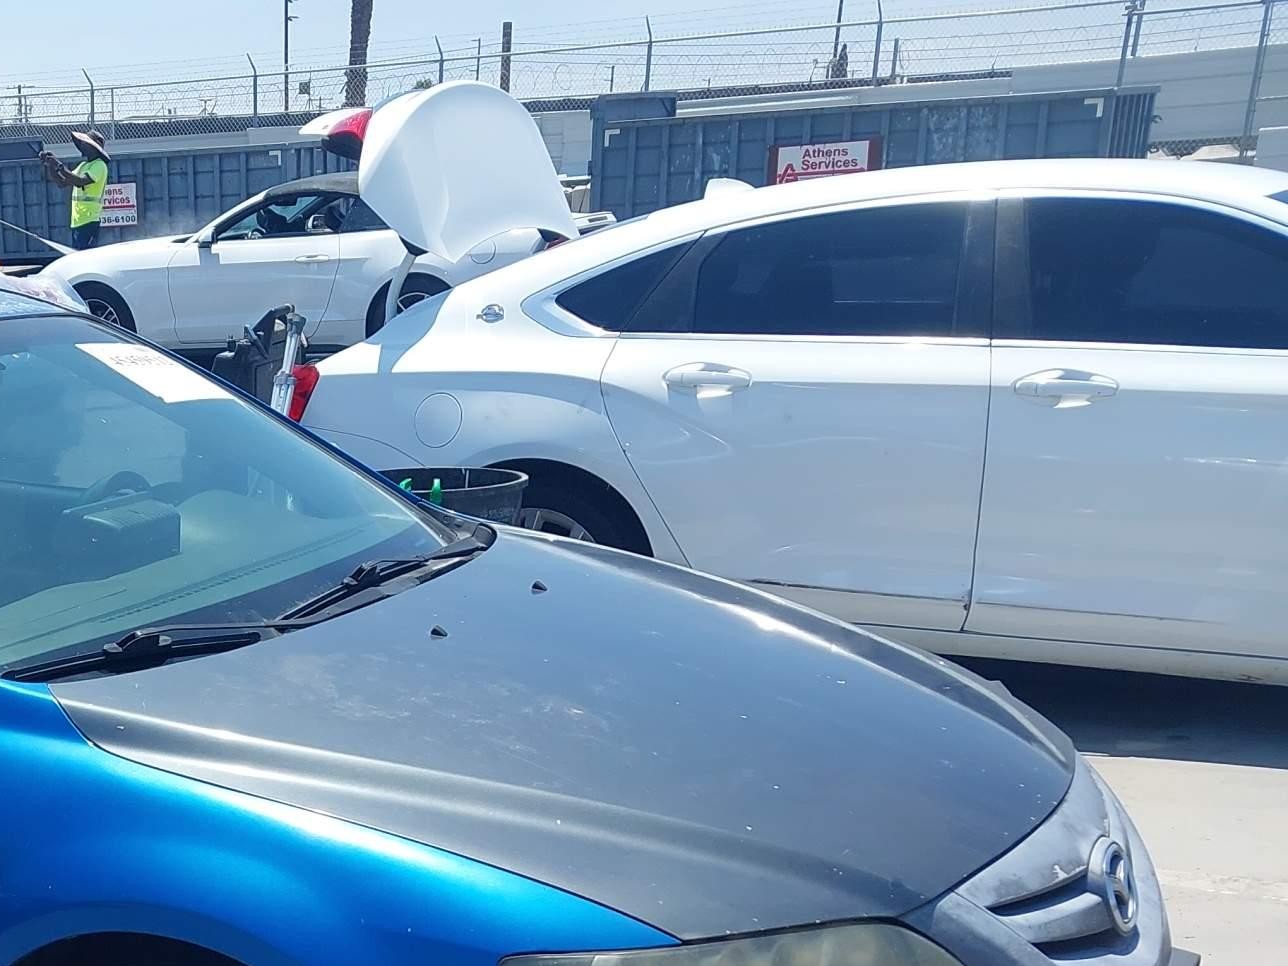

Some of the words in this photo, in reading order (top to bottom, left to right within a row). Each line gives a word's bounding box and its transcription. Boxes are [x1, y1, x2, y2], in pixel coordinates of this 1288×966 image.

[802, 147, 849, 159] Athens
[801, 158, 859, 171] Services
[103, 196, 131, 205] rvices
